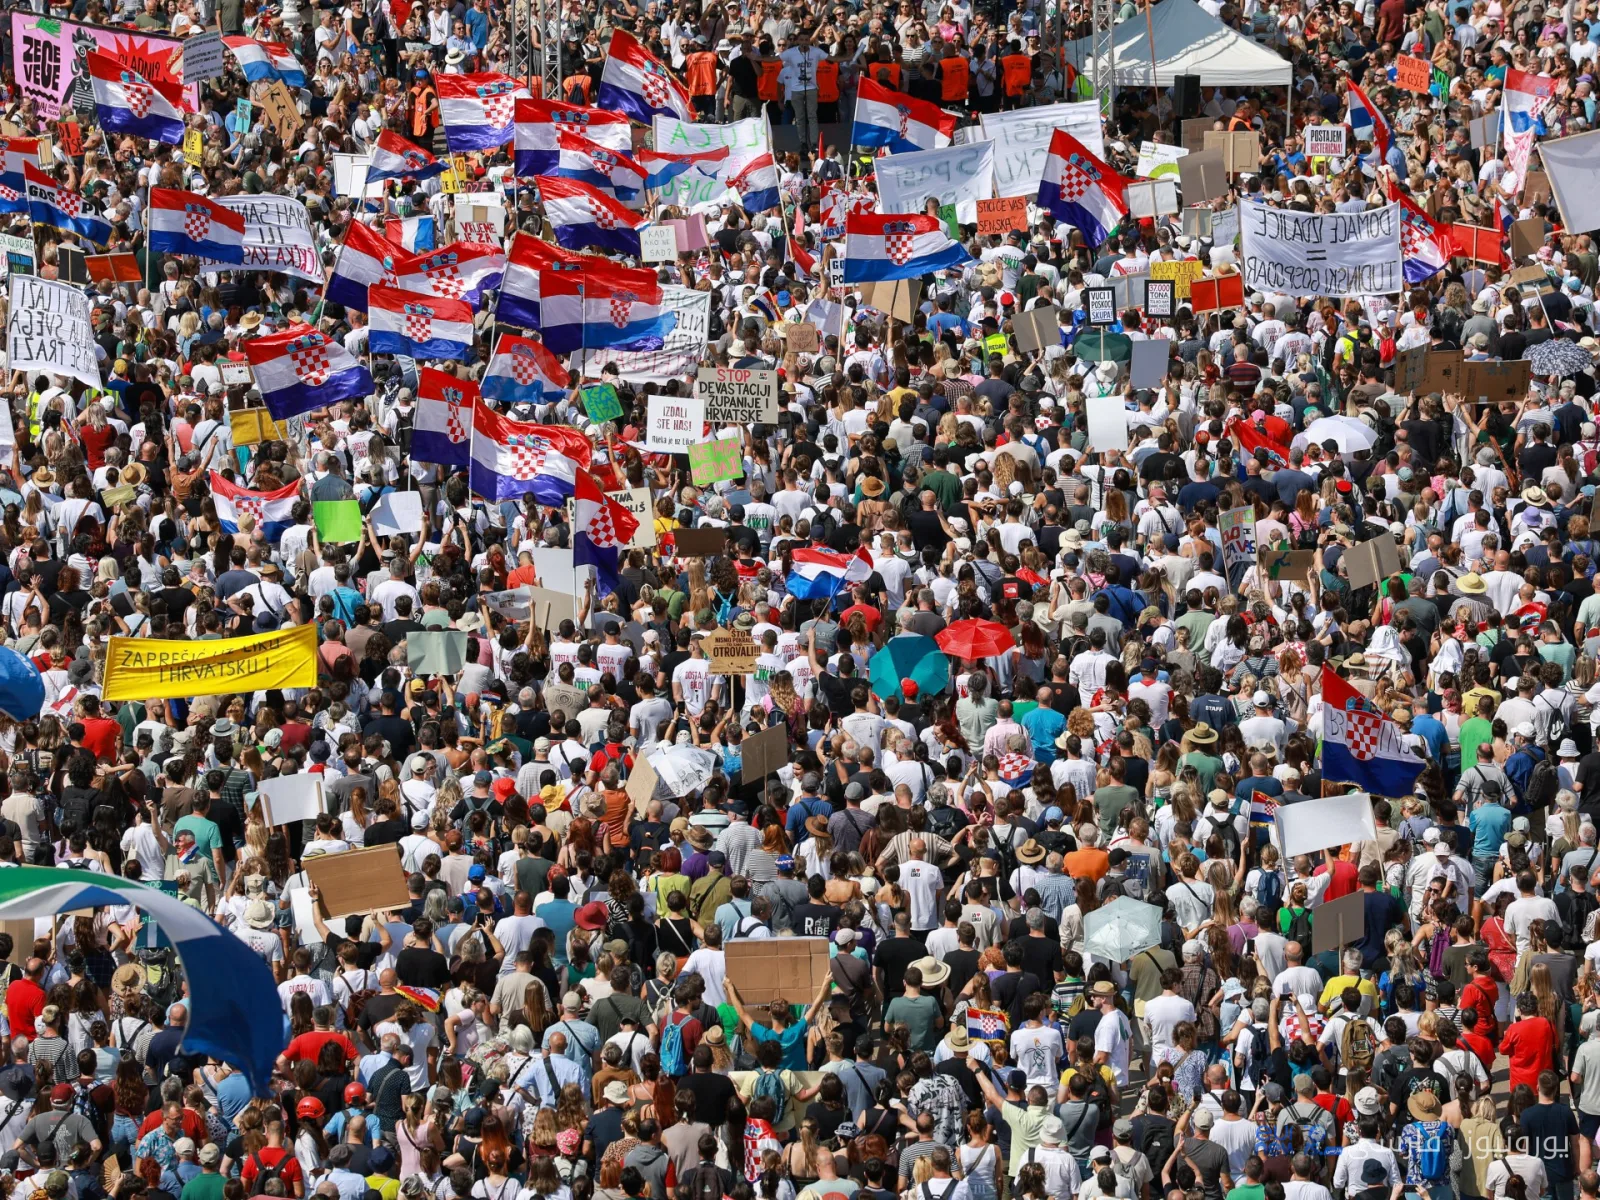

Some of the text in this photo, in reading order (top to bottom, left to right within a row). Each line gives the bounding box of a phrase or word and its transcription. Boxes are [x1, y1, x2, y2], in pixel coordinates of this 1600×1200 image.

[1311, 130, 1342, 142] POSTAJEM
[460, 222, 497, 233] VRIJEME
[476, 233, 493, 243] ZA
[648, 229, 670, 238] KAD?
[650, 248, 672, 257] SAD?
[1149, 284, 1170, 292] 37.000
[1092, 310, 1112, 320] SKUPA!
[988, 343, 1006, 351] REDAR
[717, 369, 751, 383] STOP
[699, 381, 771, 397] DEVASTACIJI
[709, 393, 769, 409] ŽUPANIJE I
[663, 406, 687, 418] IZDALI
[706, 408, 763, 422] HRVATSKE
[657, 418, 692, 432] STE NAS!
[652, 436, 667, 444] Rijeka
[731, 629, 746, 638] ŠTO
[713, 646, 761, 657] OTROVALI!!!
[555, 654, 569, 662] DOSTA
[598, 656, 614, 665] DOSTA
[170, 661, 257, 683] HRVATSKU
[685, 671, 702, 680] DOSTA
